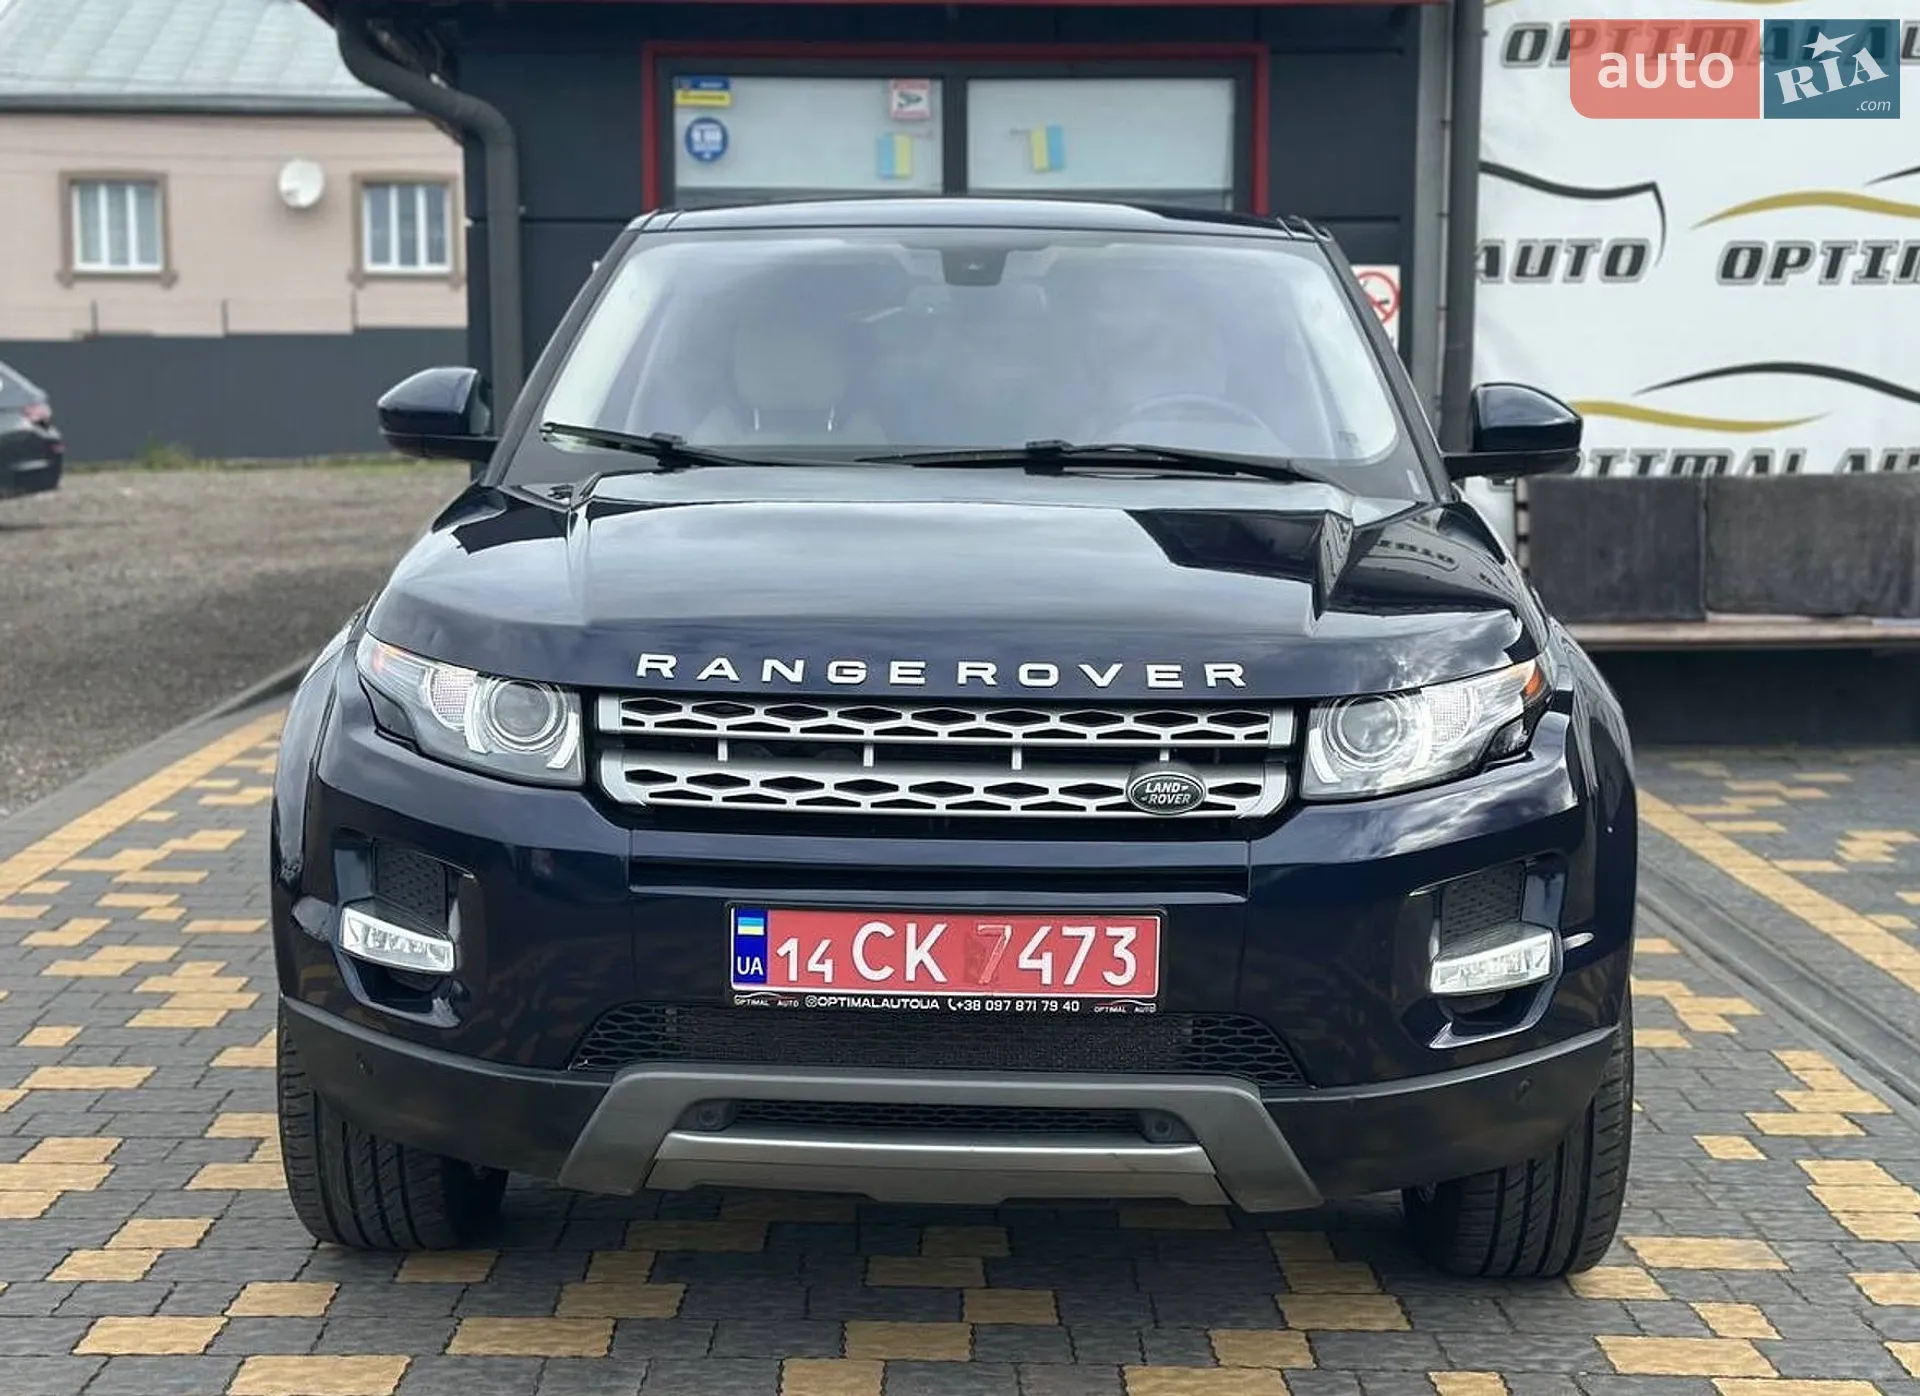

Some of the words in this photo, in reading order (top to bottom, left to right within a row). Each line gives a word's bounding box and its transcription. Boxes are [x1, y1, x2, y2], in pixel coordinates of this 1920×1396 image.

[1477, 238, 1652, 284] AUTO
[1573, 447, 1807, 475] TIMAL
[636, 653, 926, 686] RANGE
[956, 660, 1246, 689] ROVER
[1145, 782, 1181, 793] LAND
[1147, 793, 1191, 805] ROVER
[776, 937, 835, 983] 14
[852, 921, 949, 983] CK
[976, 923, 1138, 987] 7473
[736, 956, 764, 976] UA
[777, 999, 800, 1008] AUTO
[985, 1000, 1011, 1012] 097
[1015, 1000, 1037, 1012] 871
[1042, 1000, 1059, 1012] 79
[1062, 1001, 1080, 1012] 40
